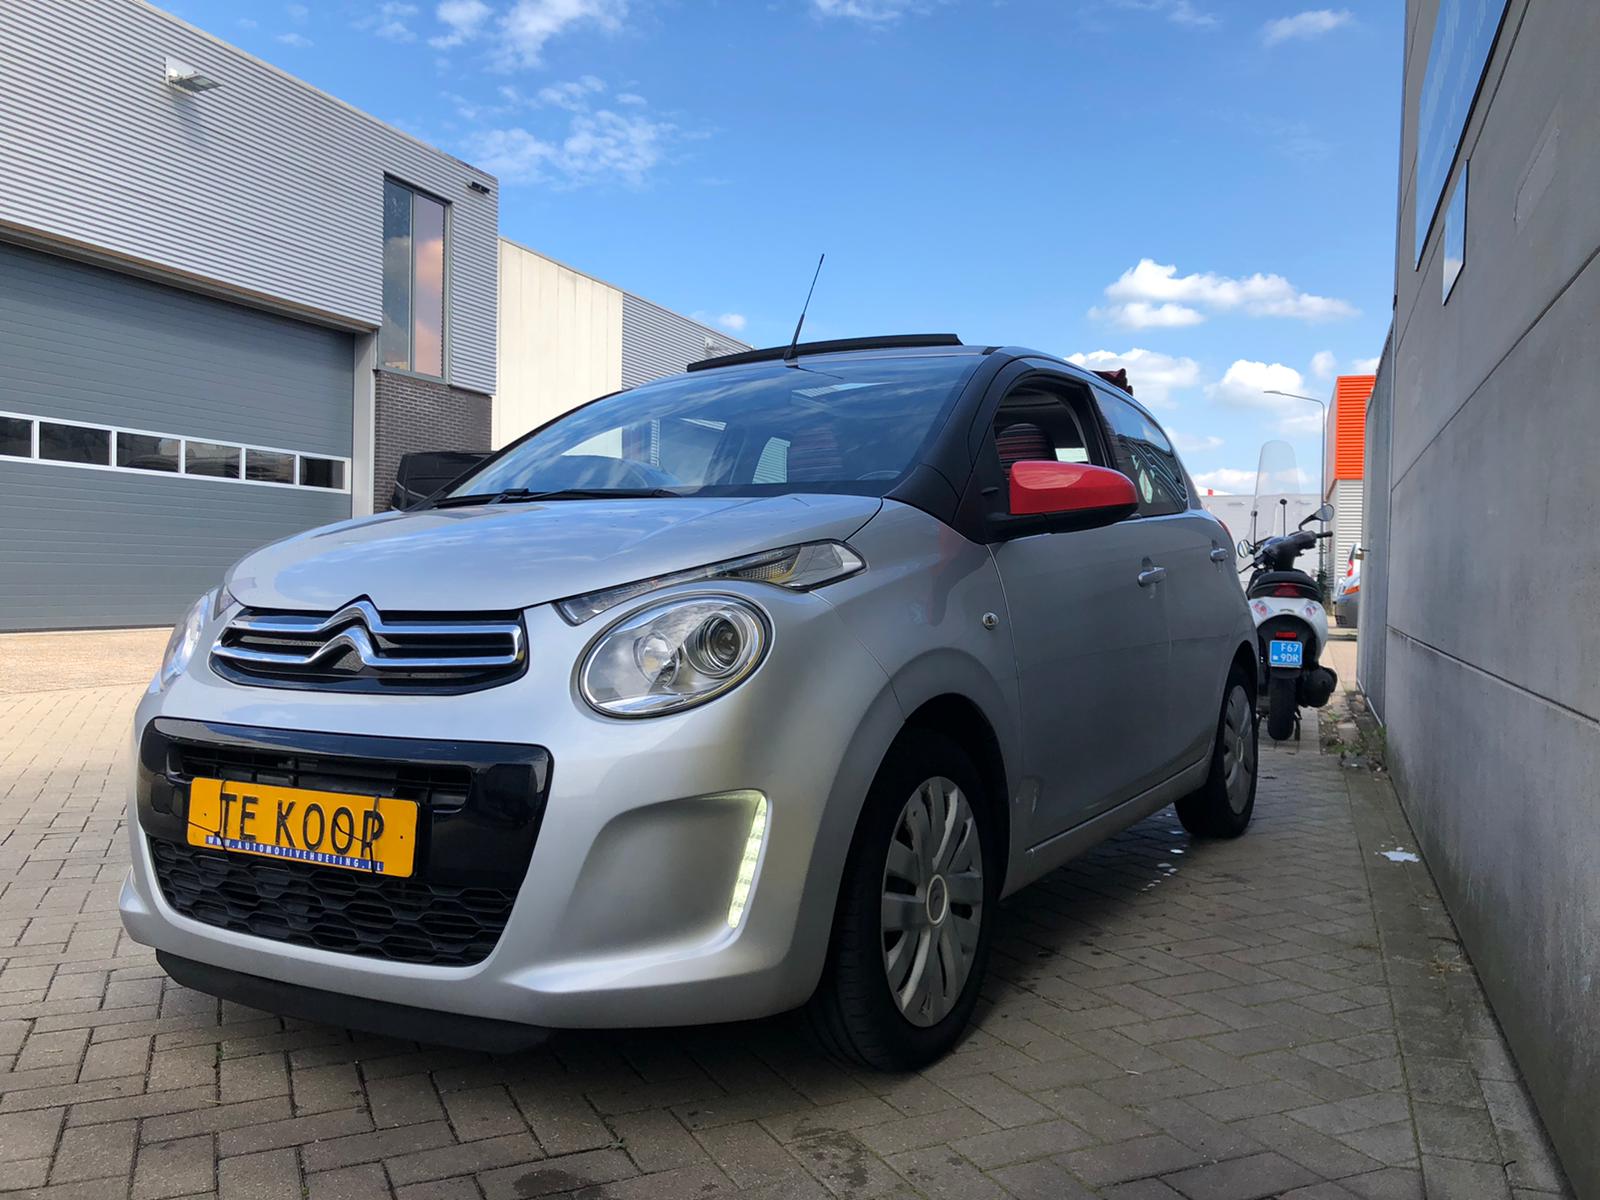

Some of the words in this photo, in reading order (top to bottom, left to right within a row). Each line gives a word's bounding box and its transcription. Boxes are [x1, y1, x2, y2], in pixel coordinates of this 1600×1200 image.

[1281, 643, 1299, 652] F67
[220, 793, 259, 841] TE
[275, 800, 384, 857] KOOP
